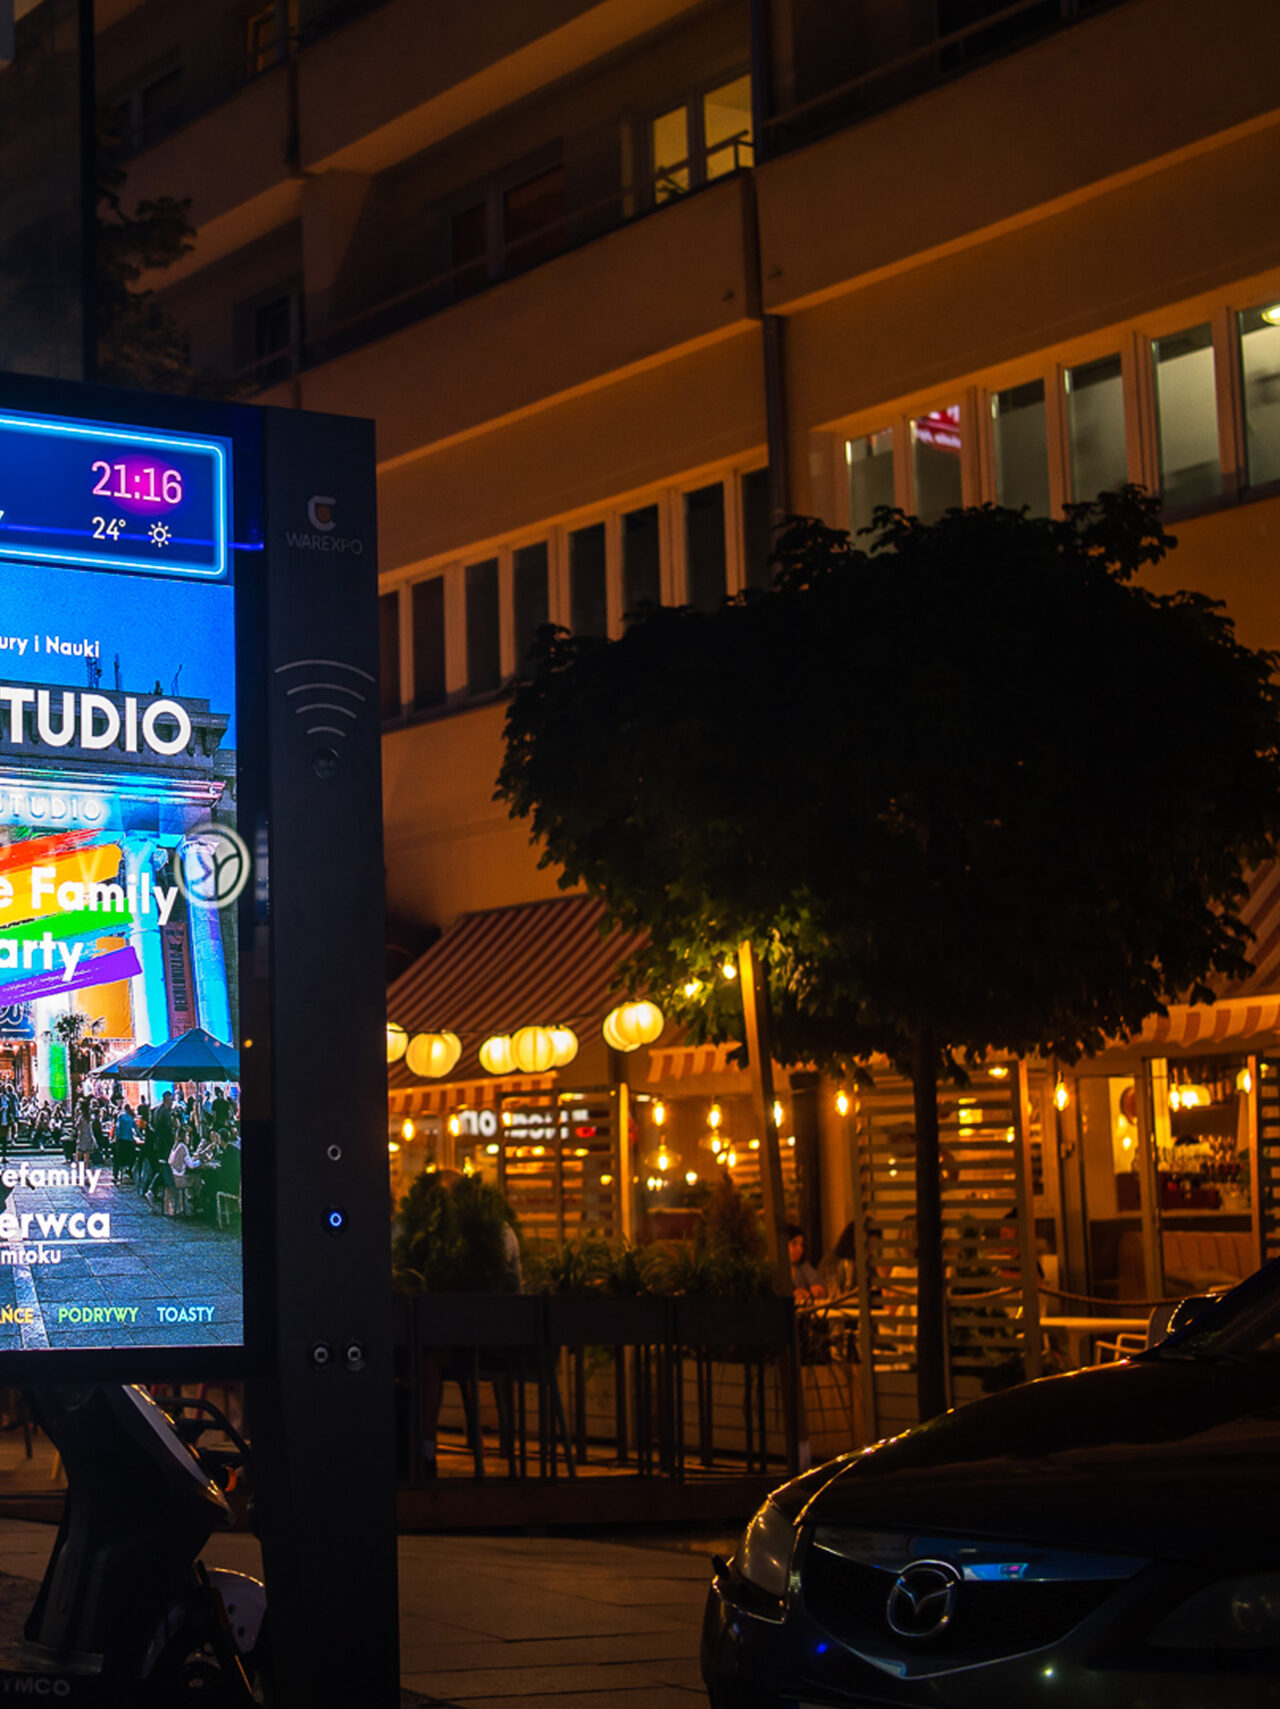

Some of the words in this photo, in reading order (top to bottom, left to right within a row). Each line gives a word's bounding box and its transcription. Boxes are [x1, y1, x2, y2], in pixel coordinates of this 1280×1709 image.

[91, 460, 182, 504] 21:16
[92, 516, 126, 541] 24°
[285, 531, 364, 556] WAREXPO
[34, 634, 40, 653] i
[46, 636, 100, 658] Nauki
[31, 866, 178, 926] Family
[58, 1307, 139, 1324] PODRYWY
[157, 1306, 215, 1323] TOASTY
